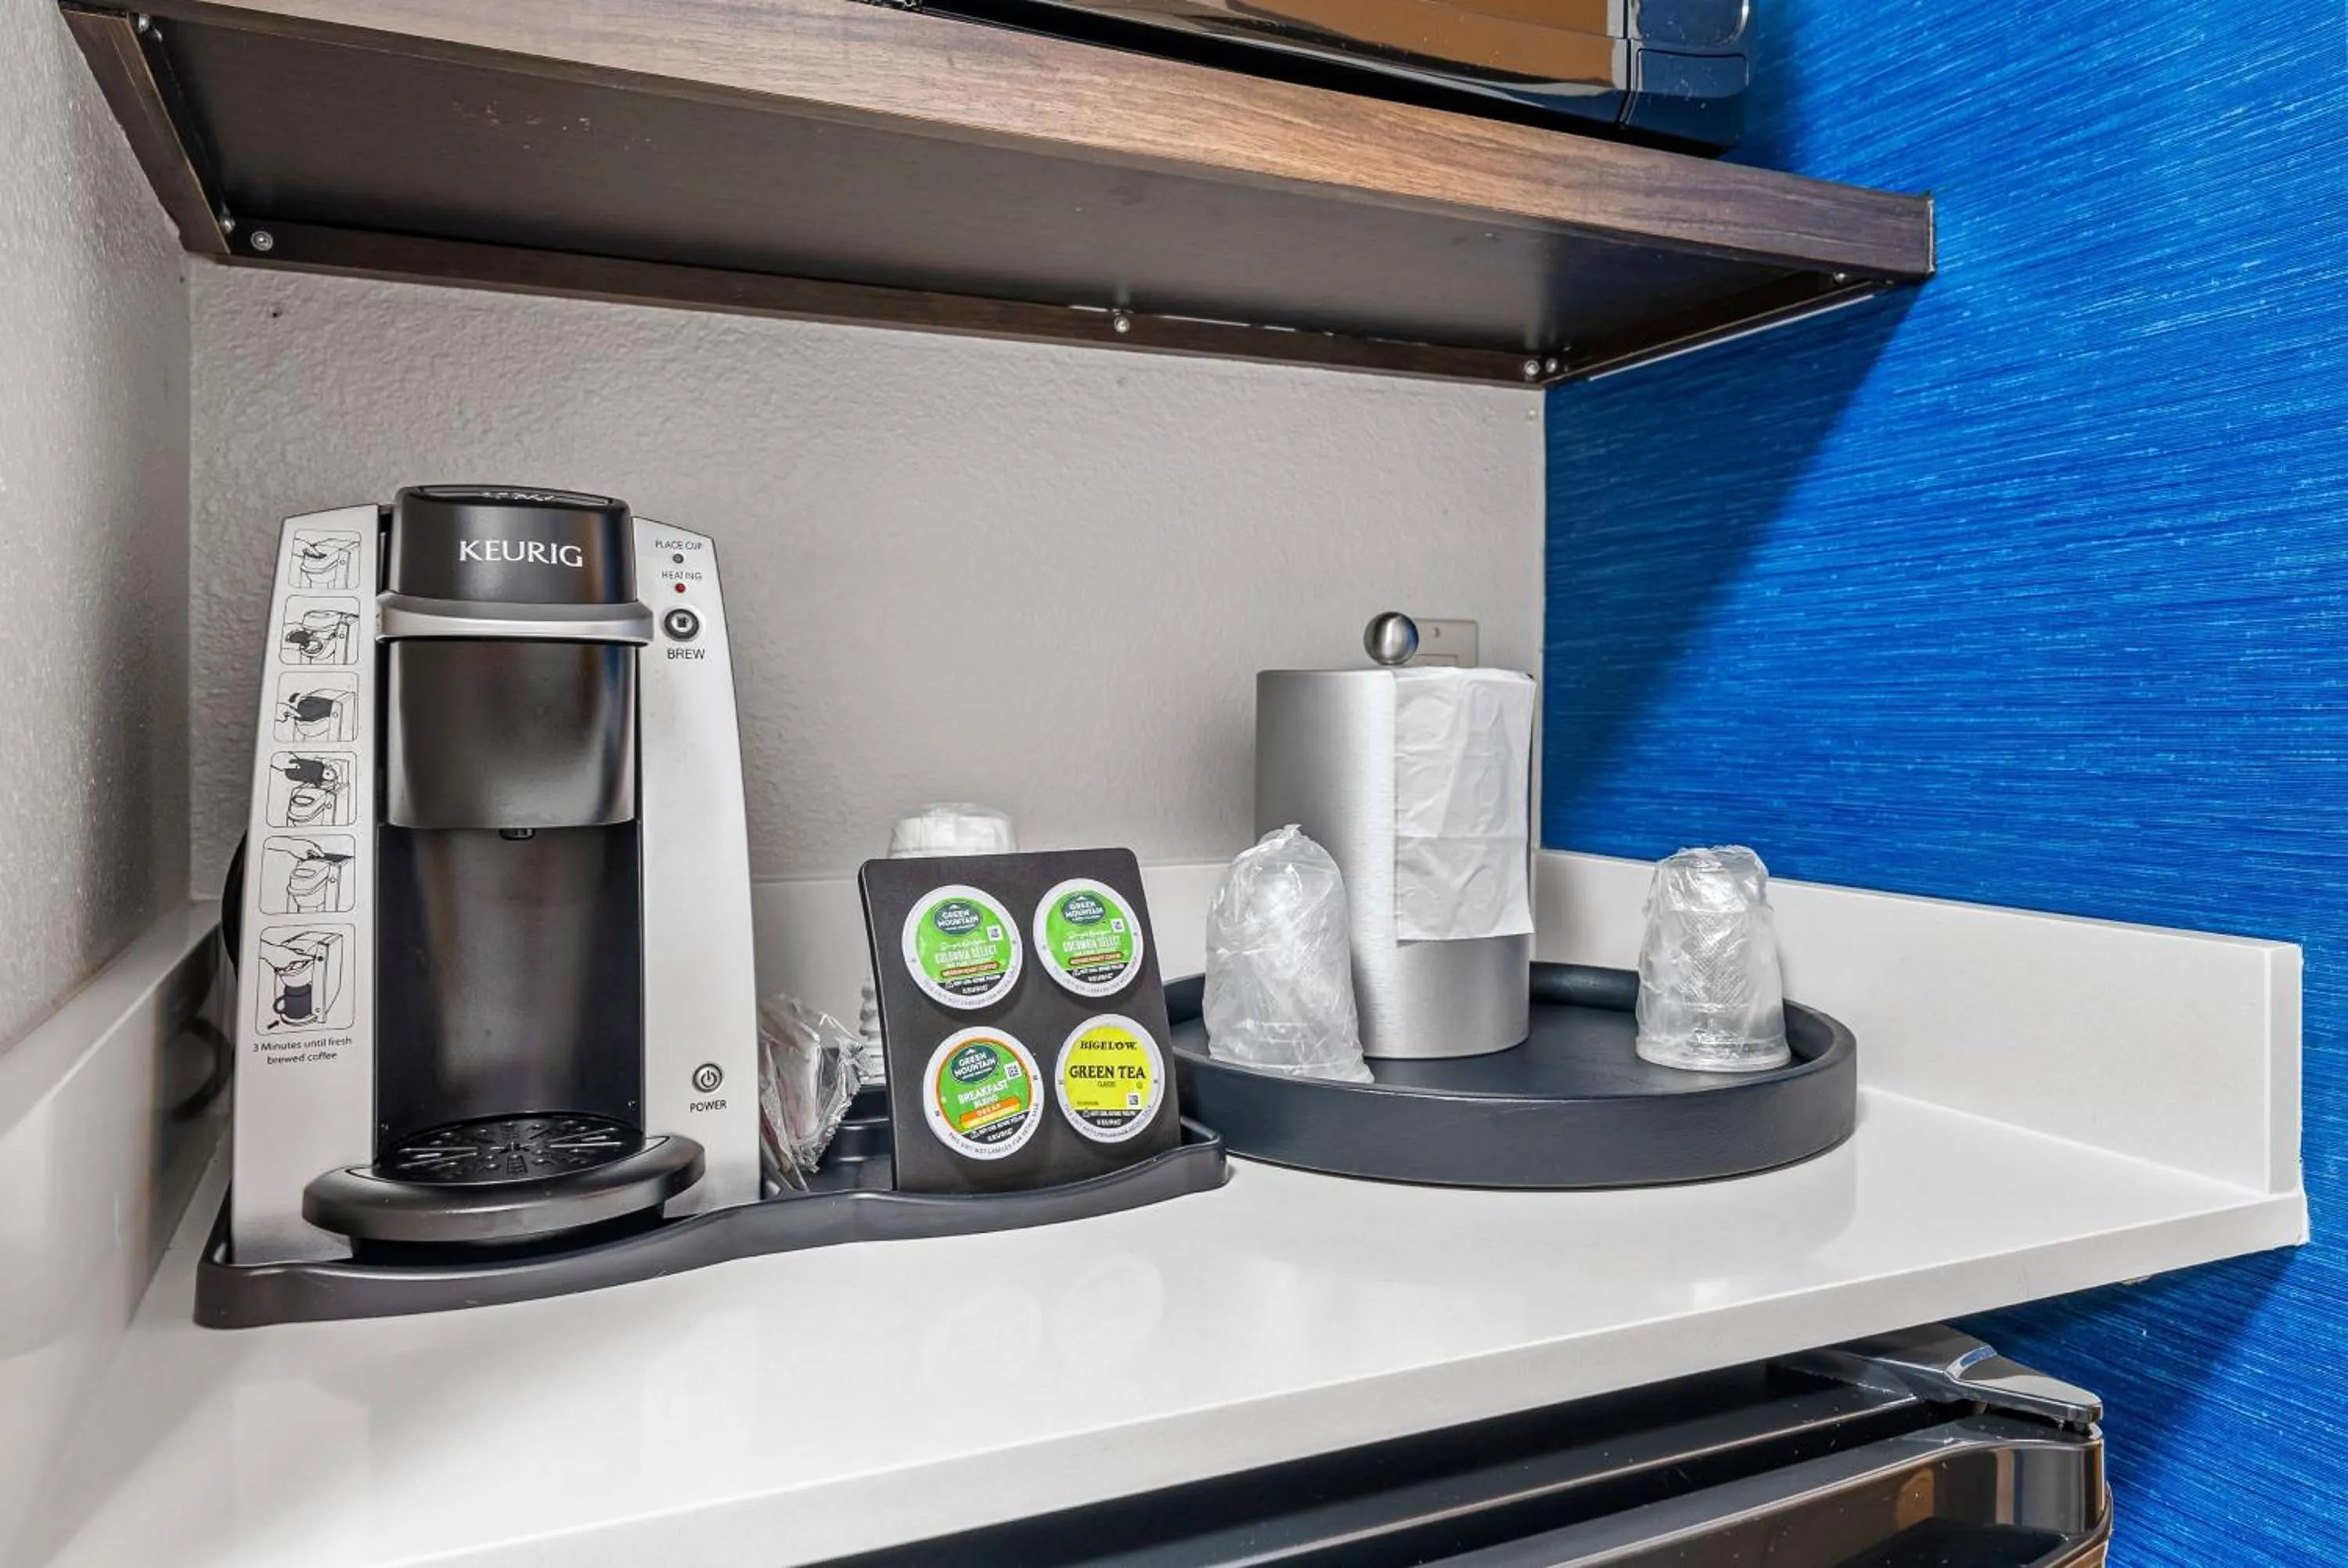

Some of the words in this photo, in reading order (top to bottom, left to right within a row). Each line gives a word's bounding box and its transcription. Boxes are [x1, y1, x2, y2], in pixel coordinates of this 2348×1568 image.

[655, 539, 683, 549] PLACE
[685, 541, 703, 550] CUP
[459, 540, 583, 567] KEURIG
[661, 570, 703, 581] HEATING
[667, 648, 705, 660] BREW
[1069, 901, 1097, 910] GREEN
[942, 908, 971, 919] GREEN
[1065, 907, 1104, 918] MOUNTAIN
[937, 915, 979, 927] MOUNTAIN
[253, 1044, 259, 1052] 3
[261, 1041, 301, 1052] Minutes
[304, 1038, 326, 1048] until
[327, 1036, 352, 1046] fresh
[1080, 1041, 1136, 1051] BIGELOW
[267, 1053, 305, 1064] brewed
[308, 1052, 337, 1062] coffee
[959, 1052, 987, 1066] GREEN
[954, 1058, 996, 1077] MOUNTAIN
[1069, 1065, 1115, 1078] GREEN
[1118, 1066, 1146, 1079] TEA
[958, 1080, 1008, 1104] BREAKFAST
[690, 1099, 727, 1112] POWER
[974, 1094, 999, 1108] BLEND
